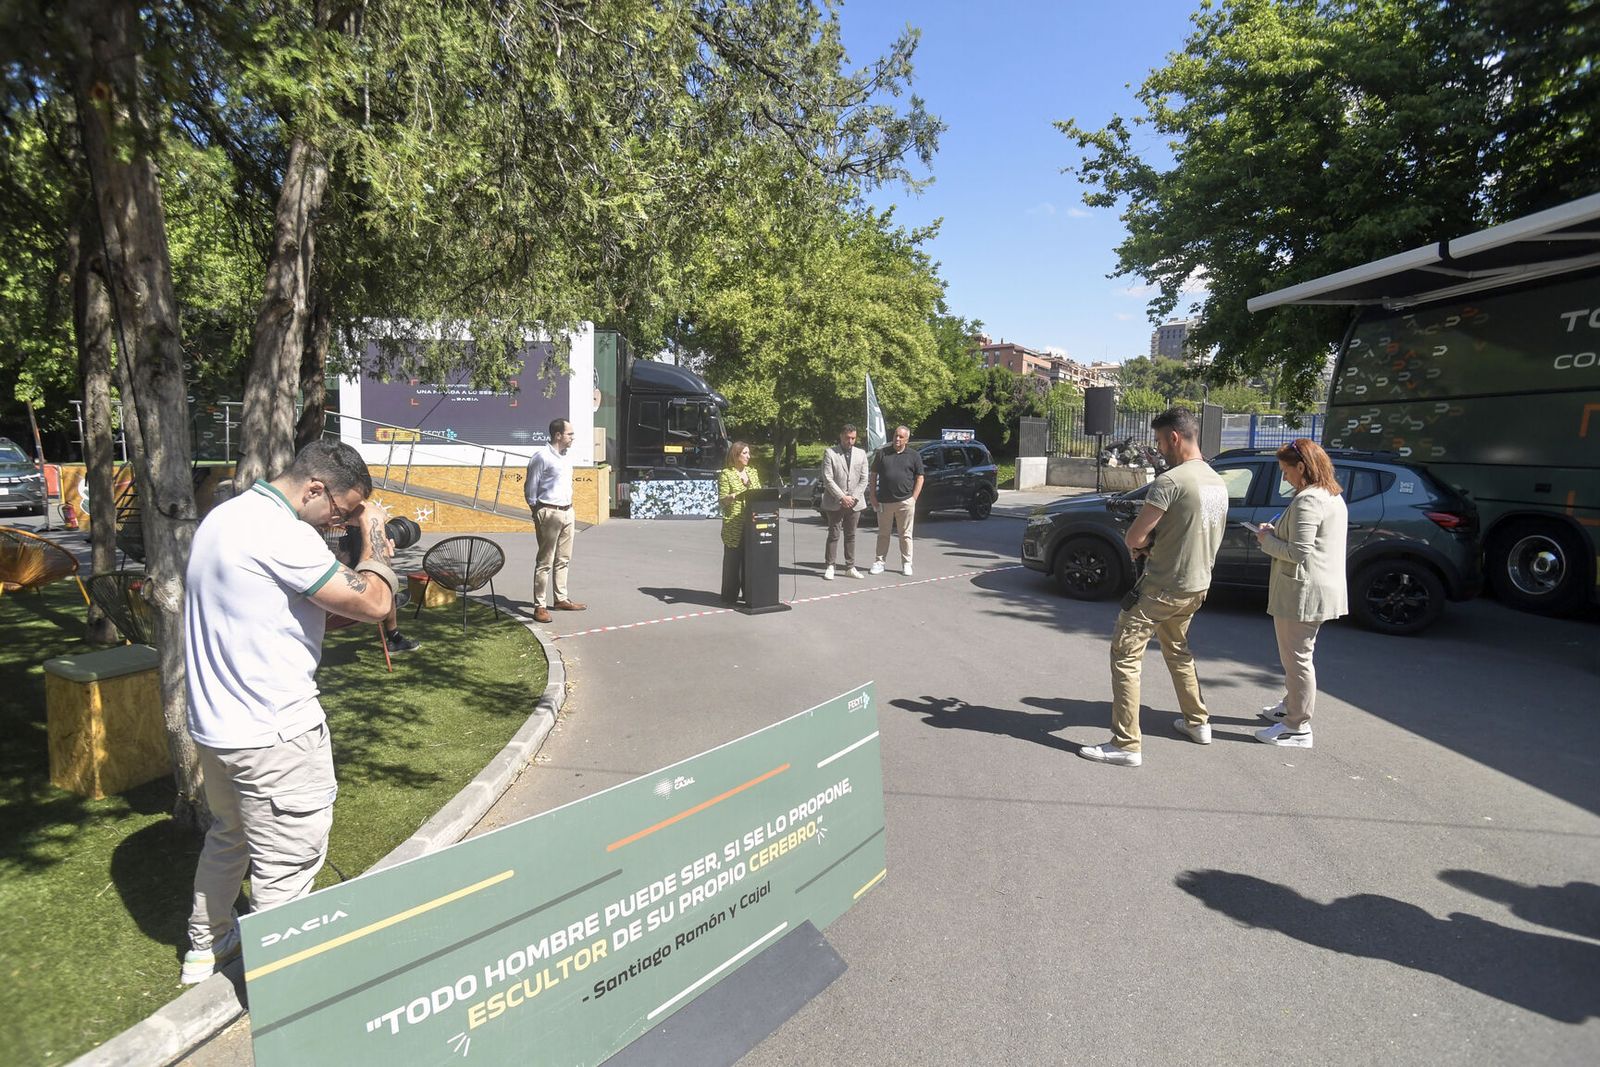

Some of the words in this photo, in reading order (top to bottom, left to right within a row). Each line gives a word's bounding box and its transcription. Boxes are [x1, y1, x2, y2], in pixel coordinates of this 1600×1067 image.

[1554, 352, 1600, 370] CO
[675, 777, 695, 790] CAJAL
[485, 912, 600, 988] HOMBRE
[604, 873, 677, 927] PUEDE
[681, 852, 722, 886] SER,
[724, 842, 740, 861] SI
[744, 831, 764, 852] SE
[768, 814, 787, 838] LO
[789, 777, 852, 827] PROPONE,
[261, 910, 348, 948] DACIA
[467, 938, 608, 1031] ESCULTOR
[612, 919, 643, 951] DE
[647, 901, 674, 931] SU
[679, 862, 746, 914] PROPIO
[593, 944, 672, 1000] Santiago
[675, 909, 726, 950] Ramón
[740, 881, 771, 909] Cajal
